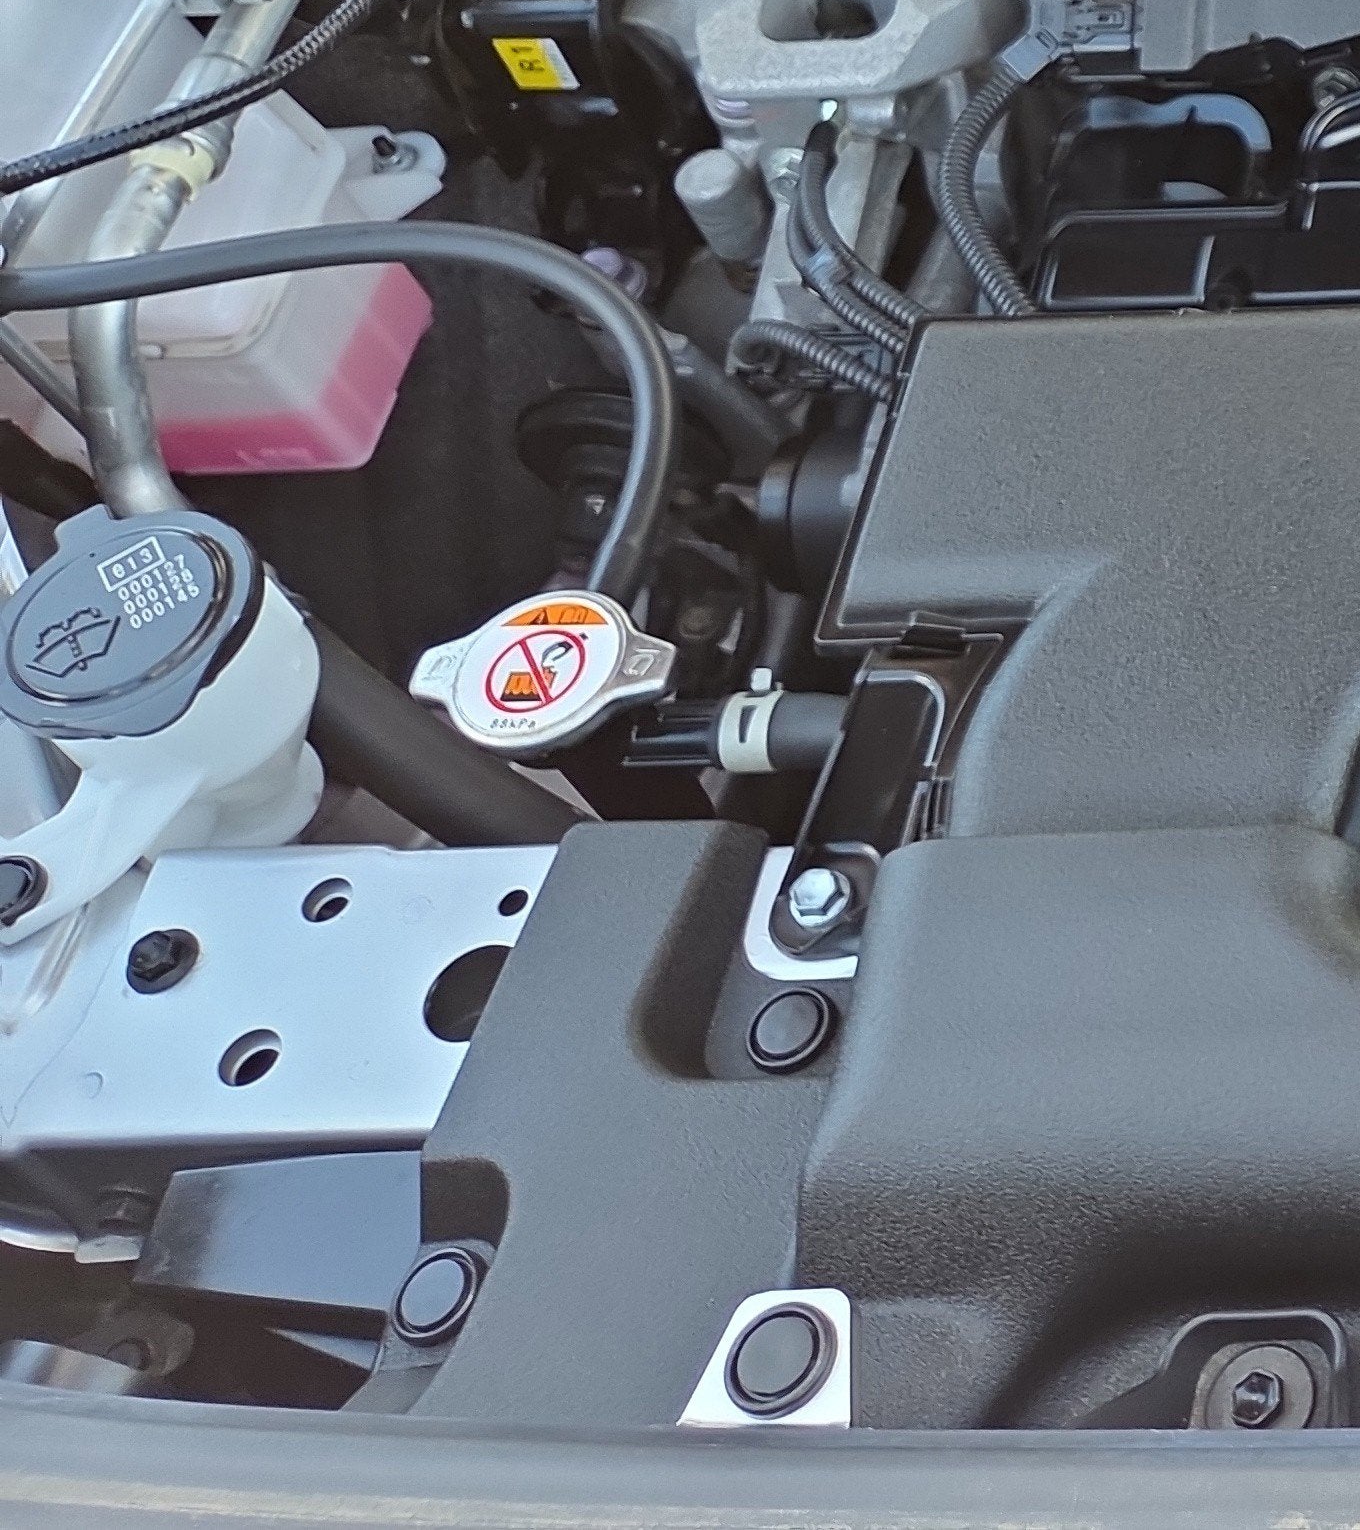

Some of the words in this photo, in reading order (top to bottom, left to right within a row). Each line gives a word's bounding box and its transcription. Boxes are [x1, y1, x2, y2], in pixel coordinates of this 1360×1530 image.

[118, 554, 185, 601] 000127
[123, 568, 194, 615] 000128
[130, 582, 200, 629] 000145
